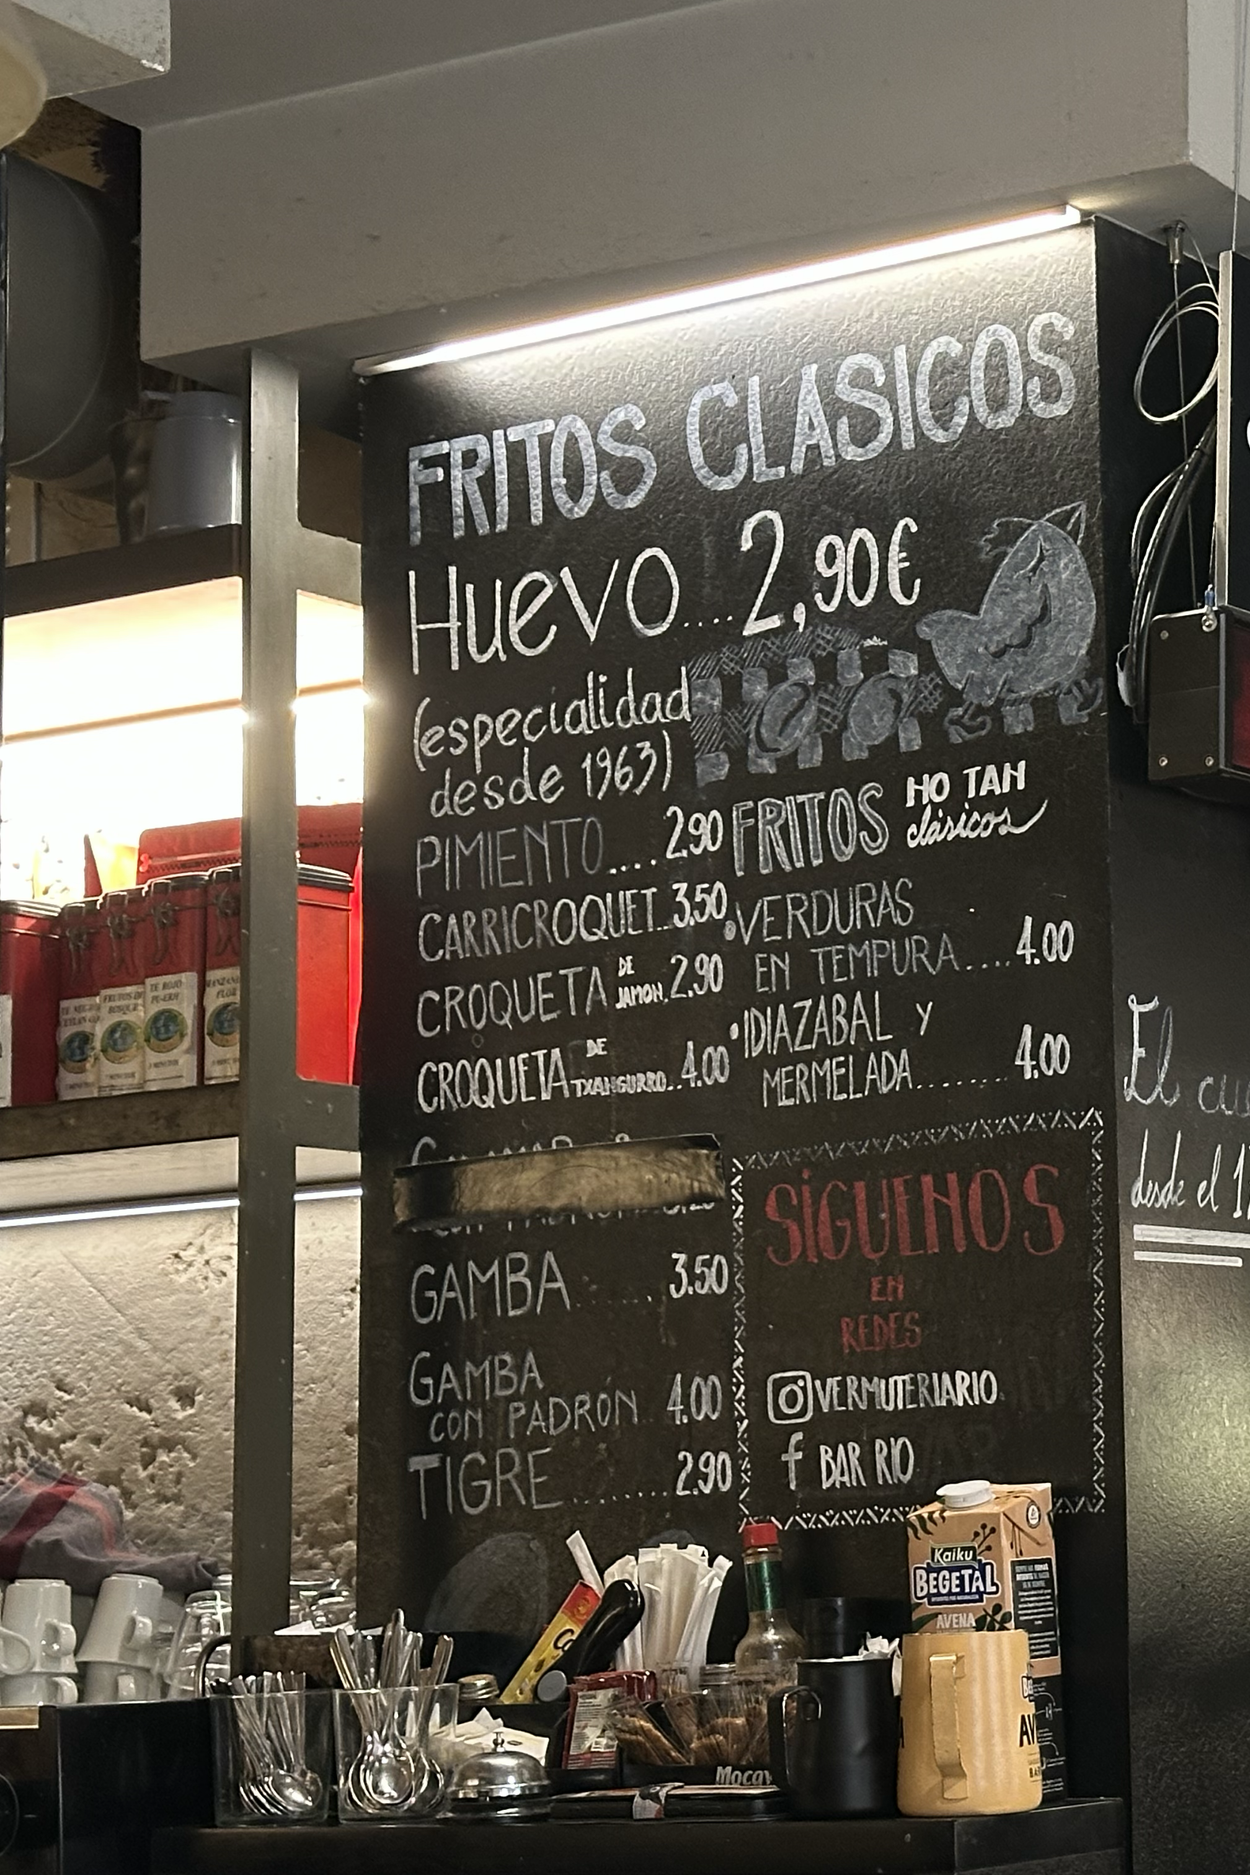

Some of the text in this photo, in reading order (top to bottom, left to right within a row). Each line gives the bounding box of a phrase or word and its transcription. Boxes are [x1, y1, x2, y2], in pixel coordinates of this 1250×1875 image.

[407, 311, 1075, 546] FRITOS CLASICOS
[740, 509, 921, 637] 2,90€
[413, 666, 692, 773] (especialidad
[430, 730, 672, 818] desde 1963)
[732, 782, 890, 877] FRITOS
[418, 881, 728, 962] CARRICROQUET 3.50
[735, 878, 915, 946] VERDURAS
[755, 951, 791, 993] EN
[1016, 915, 1075, 965] 4.00
[417, 966, 608, 1038] CROQUETA
[618, 955, 635, 977] DE
[669, 953, 724, 999] 2.90
[417, 1047, 571, 1114] CROQUETA
[586, 1038, 608, 1058] DE
[681, 1041, 730, 1087] 4.00
[1014, 1024, 1071, 1079] 4.00
[1124, 994, 1180, 1107] El
[1131, 1128, 1186, 1209] desde
[1198, 1144, 1221, 1212] el
[411, 1251, 729, 1324] GAMBA 3.50
[871, 1275, 905, 1302] EN
[841, 1311, 922, 1354] REDES
[409, 1351, 545, 1406] GAMBA
[430, 1408, 484, 1442] CON
[666, 1373, 723, 1425] 4.00
[814, 1369, 998, 1412] VERMUTERIARIO
[408, 1448, 732, 1520] TIGRE 2.90
[819, 1440, 868, 1490] BAR
[875, 1436, 915, 1484] RIO
[915, 1564, 997, 1598] BEGETAL
[934, 1547, 974, 1567] Kaiku
[936, 1612, 977, 1629] AVENA
